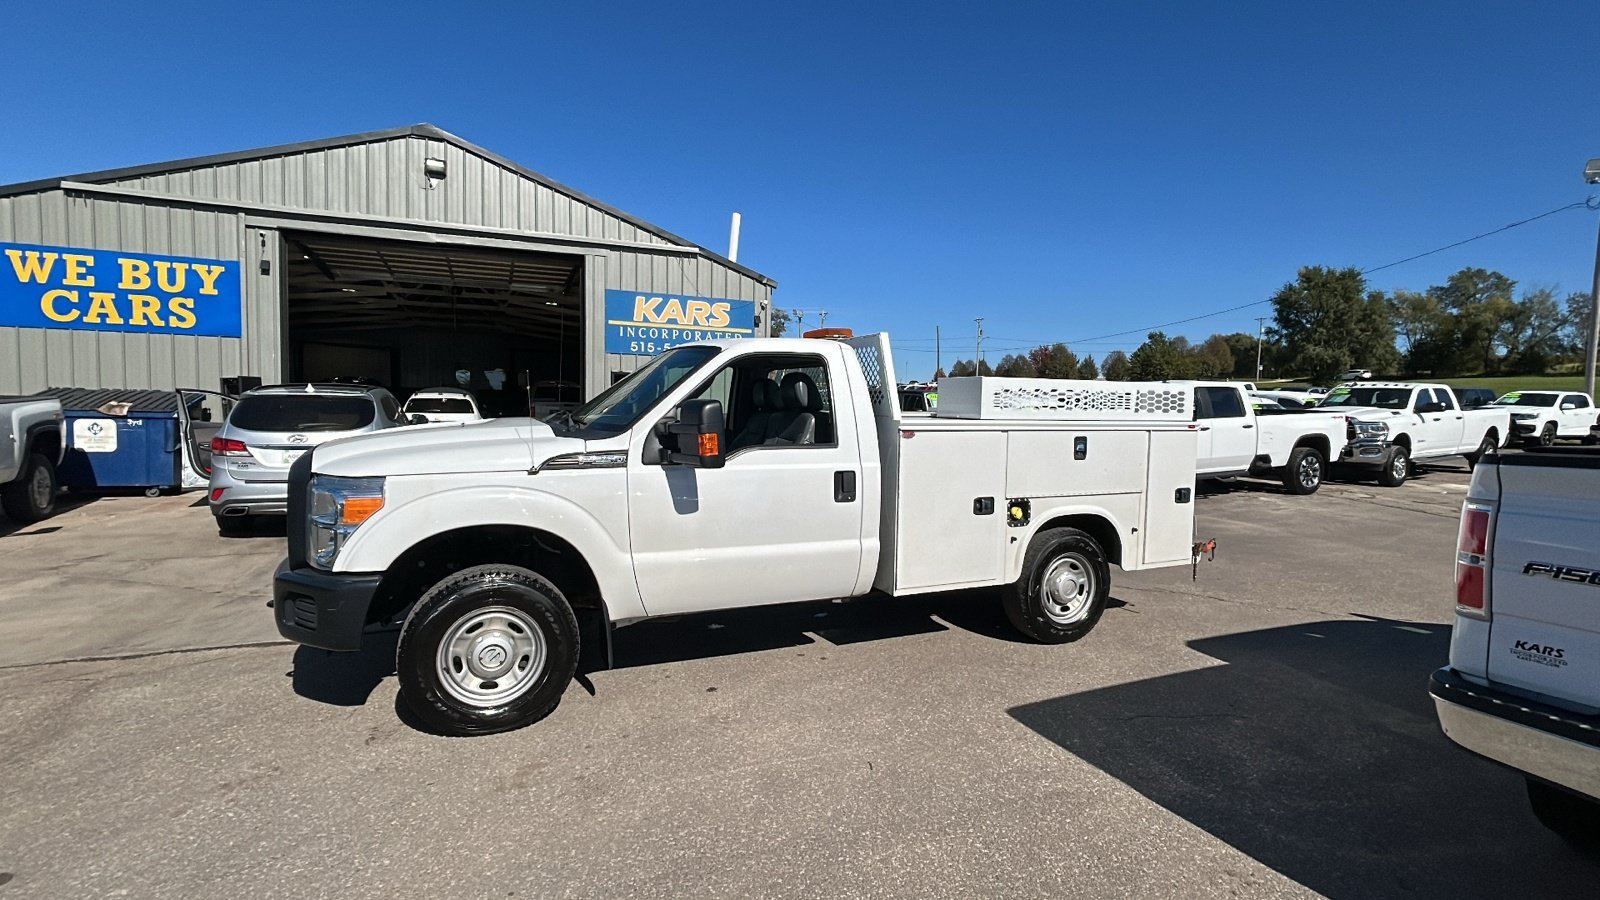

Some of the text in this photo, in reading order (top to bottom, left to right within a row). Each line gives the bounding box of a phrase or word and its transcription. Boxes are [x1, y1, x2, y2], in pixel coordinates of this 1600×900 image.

[5, 249, 225, 296] WE BUY
[40, 289, 197, 329] CARS
[633, 296, 731, 328] KARS
[1515, 640, 1565, 659] KARS
